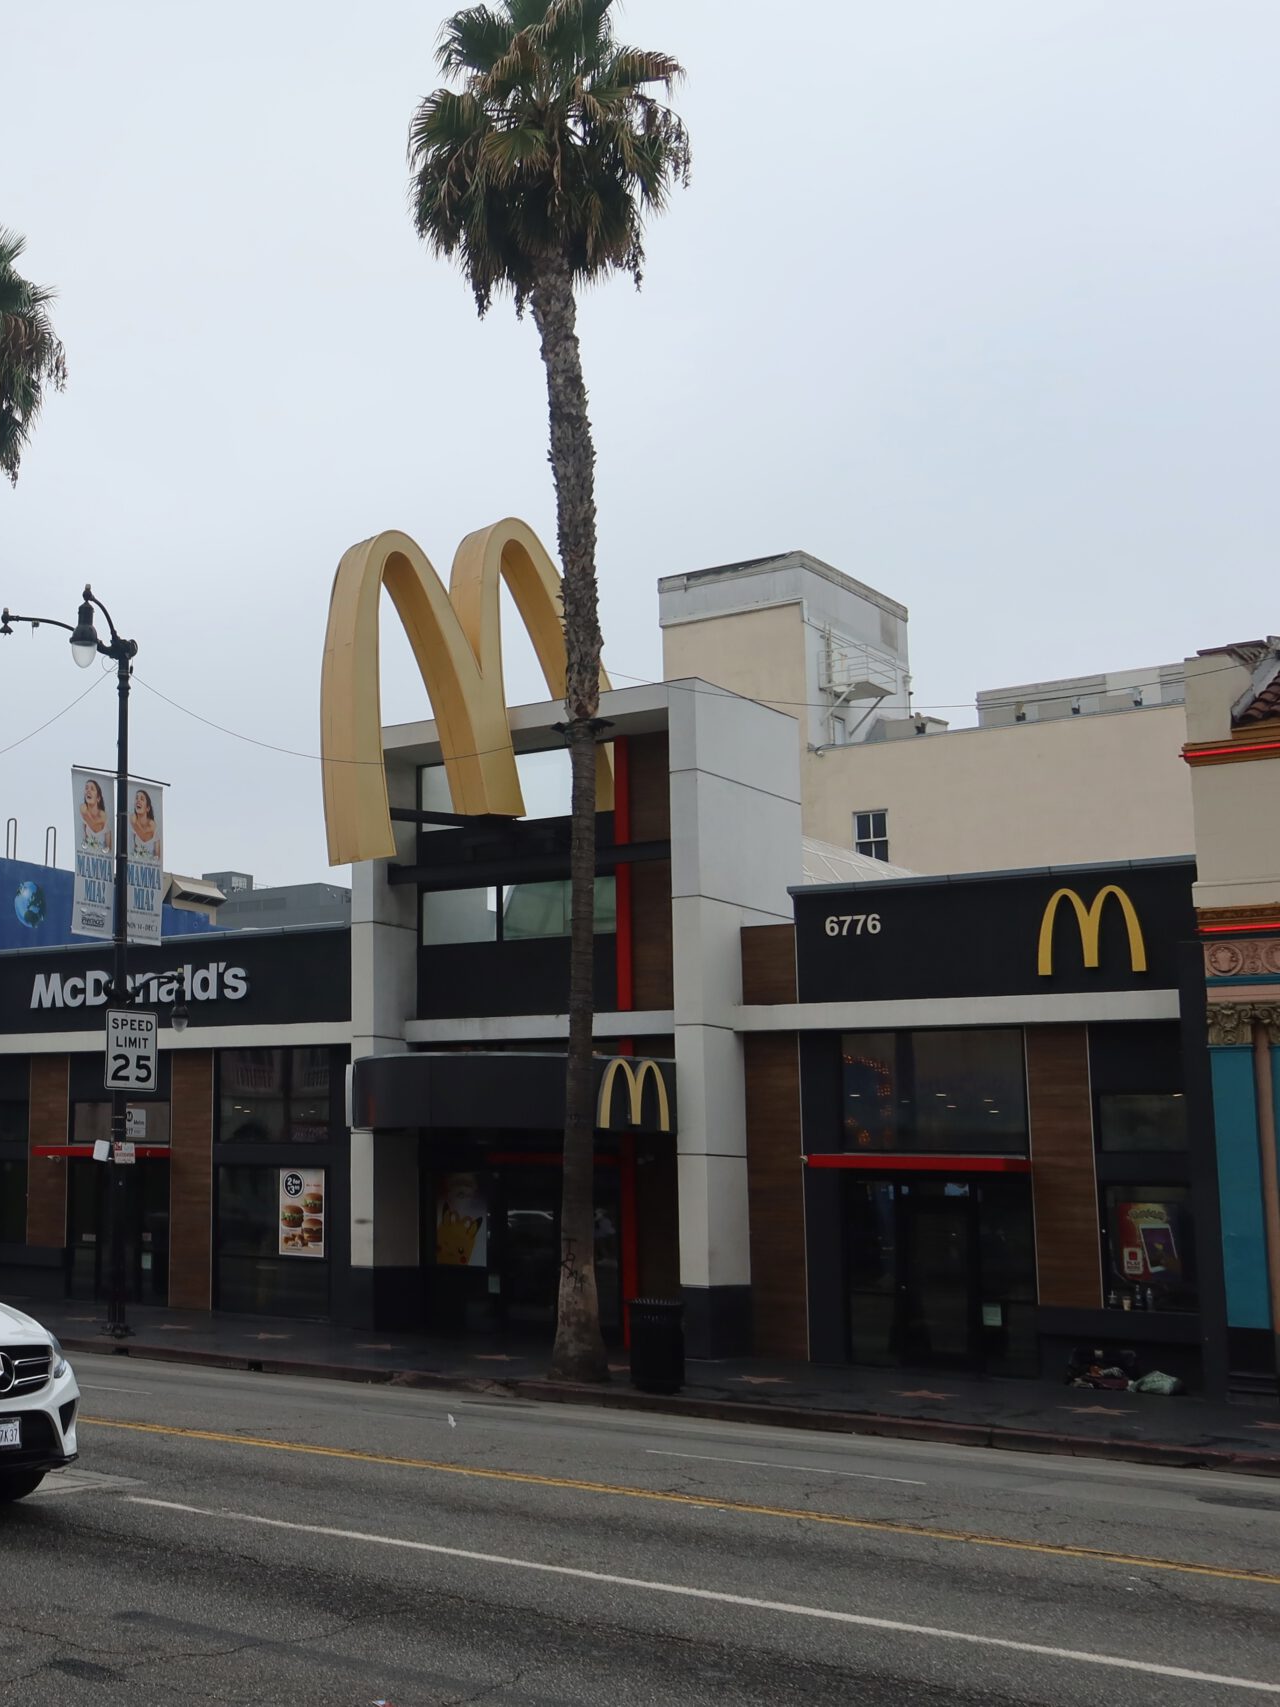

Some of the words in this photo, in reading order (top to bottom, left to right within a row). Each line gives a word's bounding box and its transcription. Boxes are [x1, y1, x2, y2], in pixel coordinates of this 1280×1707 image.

[77, 854, 113, 883] MAMMA
[127, 863, 161, 890] MAMMA
[84, 878, 106, 904] MIA!
[133, 887, 154, 912] MIA!
[825, 913, 881, 936] 6776
[112, 1018, 153, 1032] SPEED
[116, 1036, 148, 1049] LIMIT
[111, 1053, 152, 1083] 25
